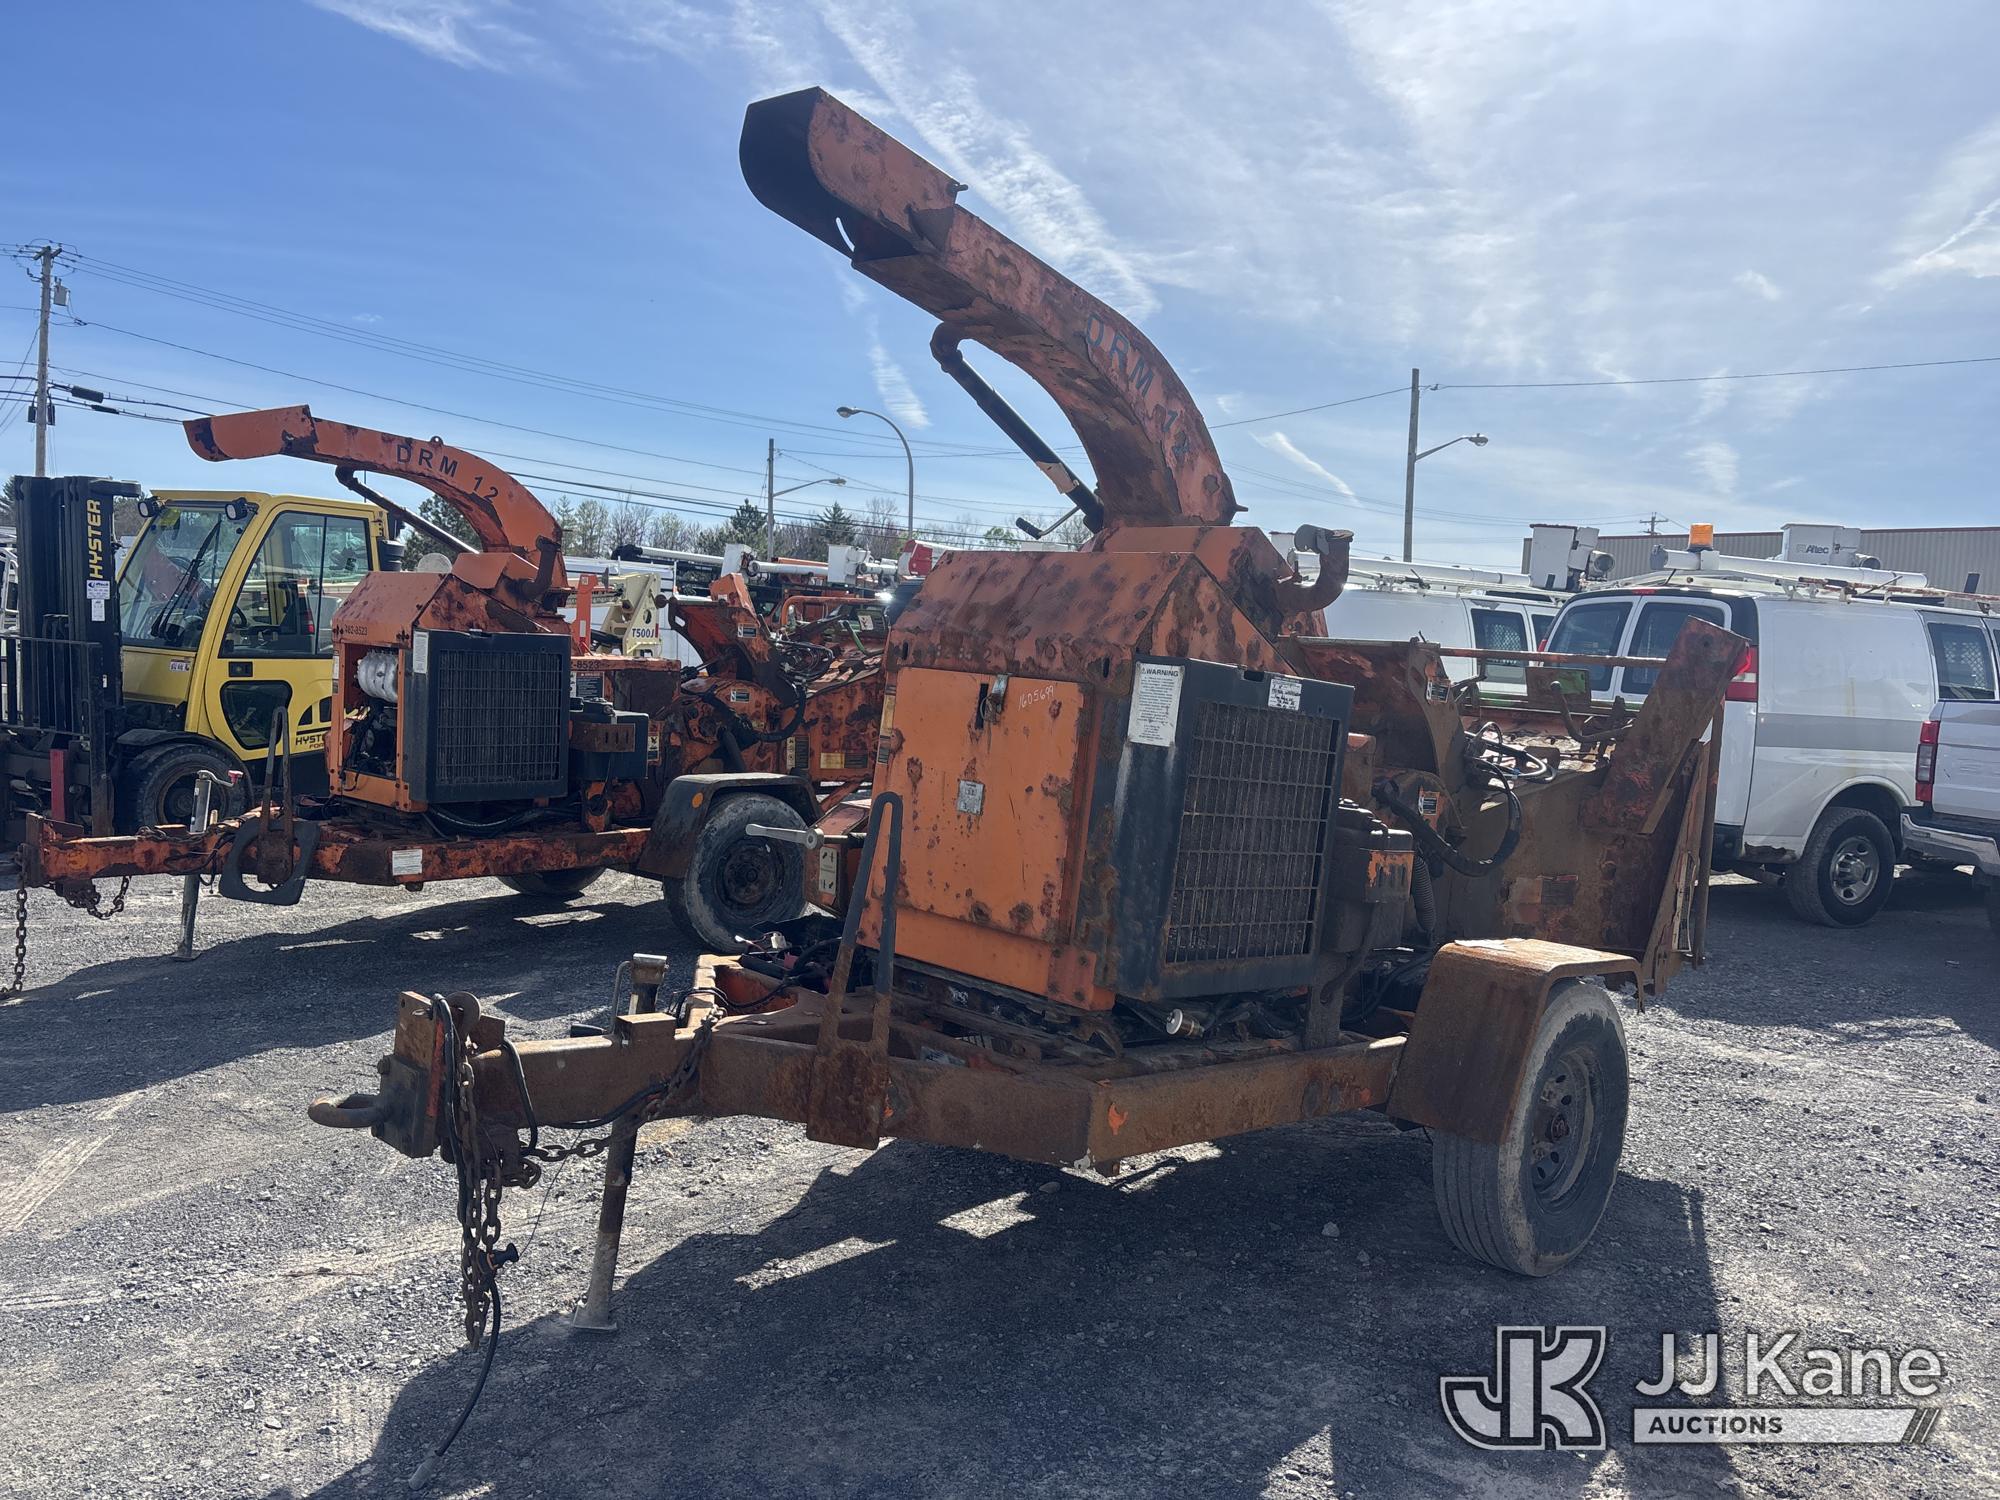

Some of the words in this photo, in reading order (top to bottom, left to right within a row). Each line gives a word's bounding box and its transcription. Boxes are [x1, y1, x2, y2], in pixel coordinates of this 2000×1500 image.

[1086, 313, 1153, 397] DRM
[396, 443, 458, 478] DRM
[473, 476, 498, 502] 12
[87, 499, 104, 579] HYSTER
[1805, 544, 1829, 554] Altec
[632, 628, 654, 638] T500J
[1146, 668, 1179, 677] WARNING
[295, 734, 324, 745] HYST
